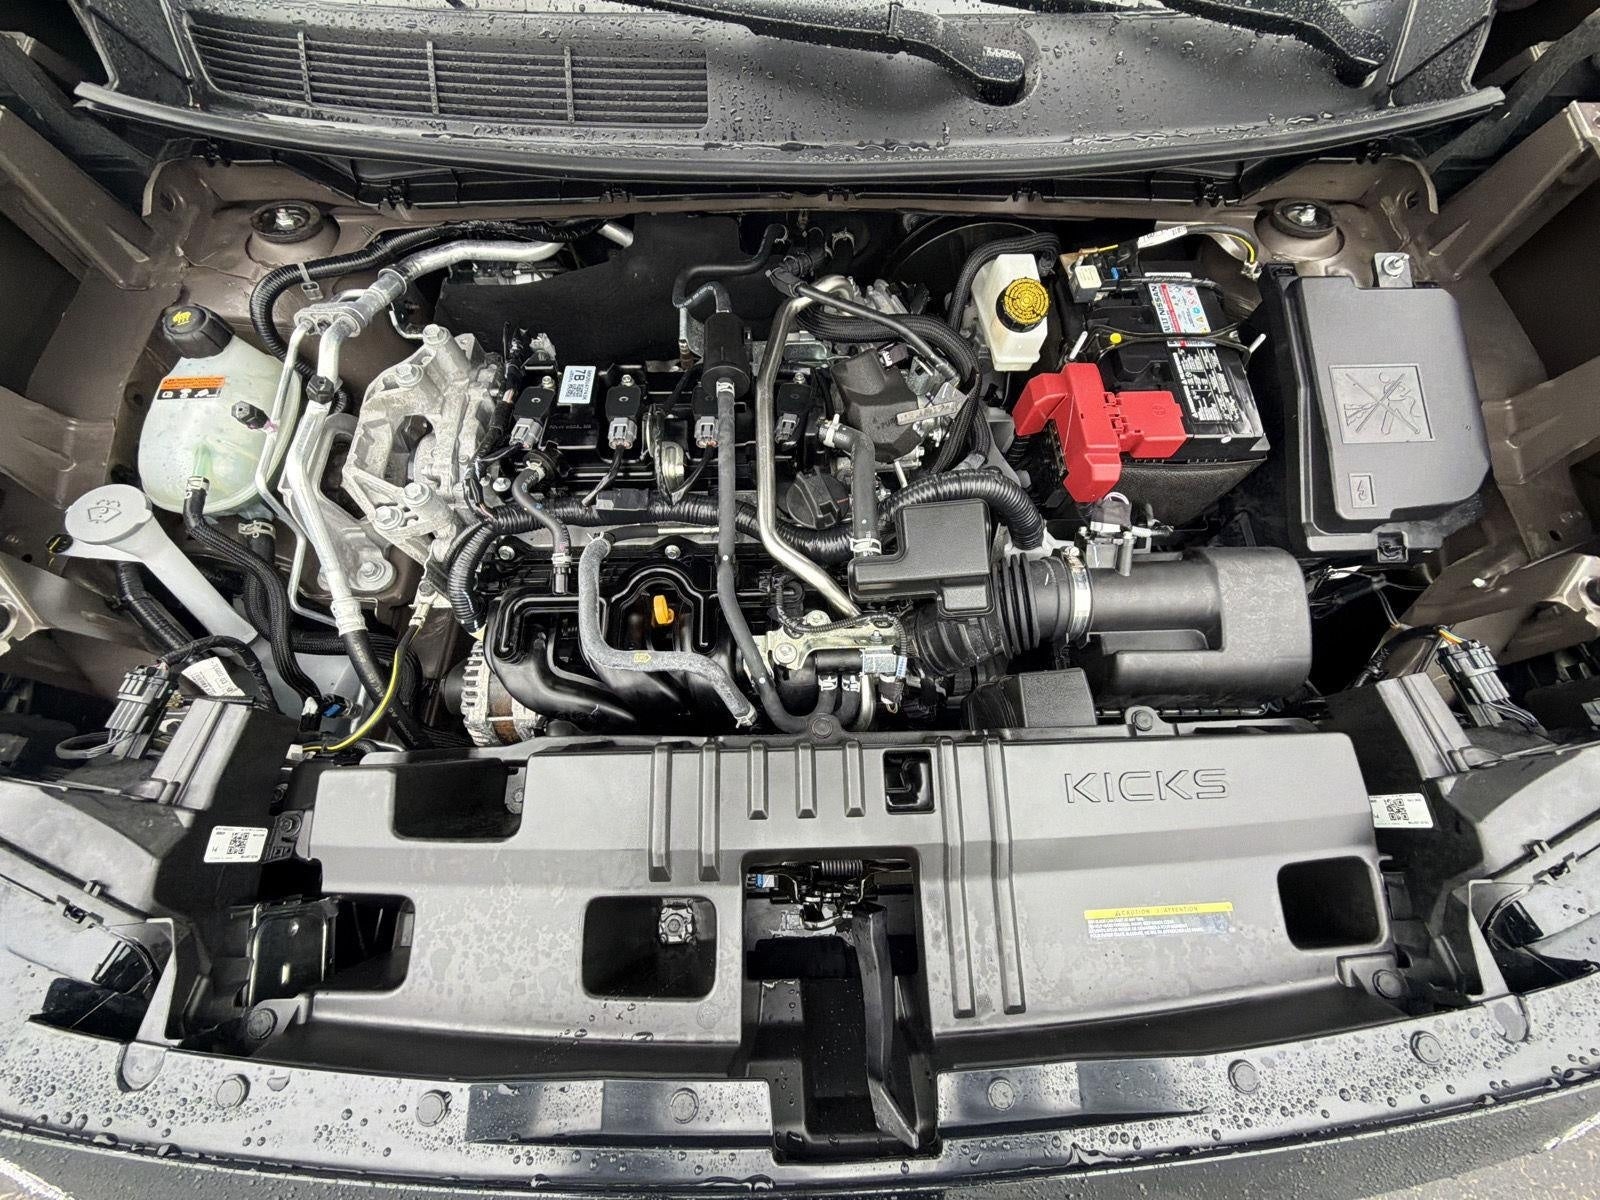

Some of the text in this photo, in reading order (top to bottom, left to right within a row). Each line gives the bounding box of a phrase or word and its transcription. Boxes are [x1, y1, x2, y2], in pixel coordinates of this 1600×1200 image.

[1151, 285, 1166, 316] NISSAN
[573, 369, 587, 381] 7B
[1064, 768, 1230, 804] KICKS
[1122, 908, 1151, 917] CAUTION
[1163, 905, 1199, 914] ATTENTION
